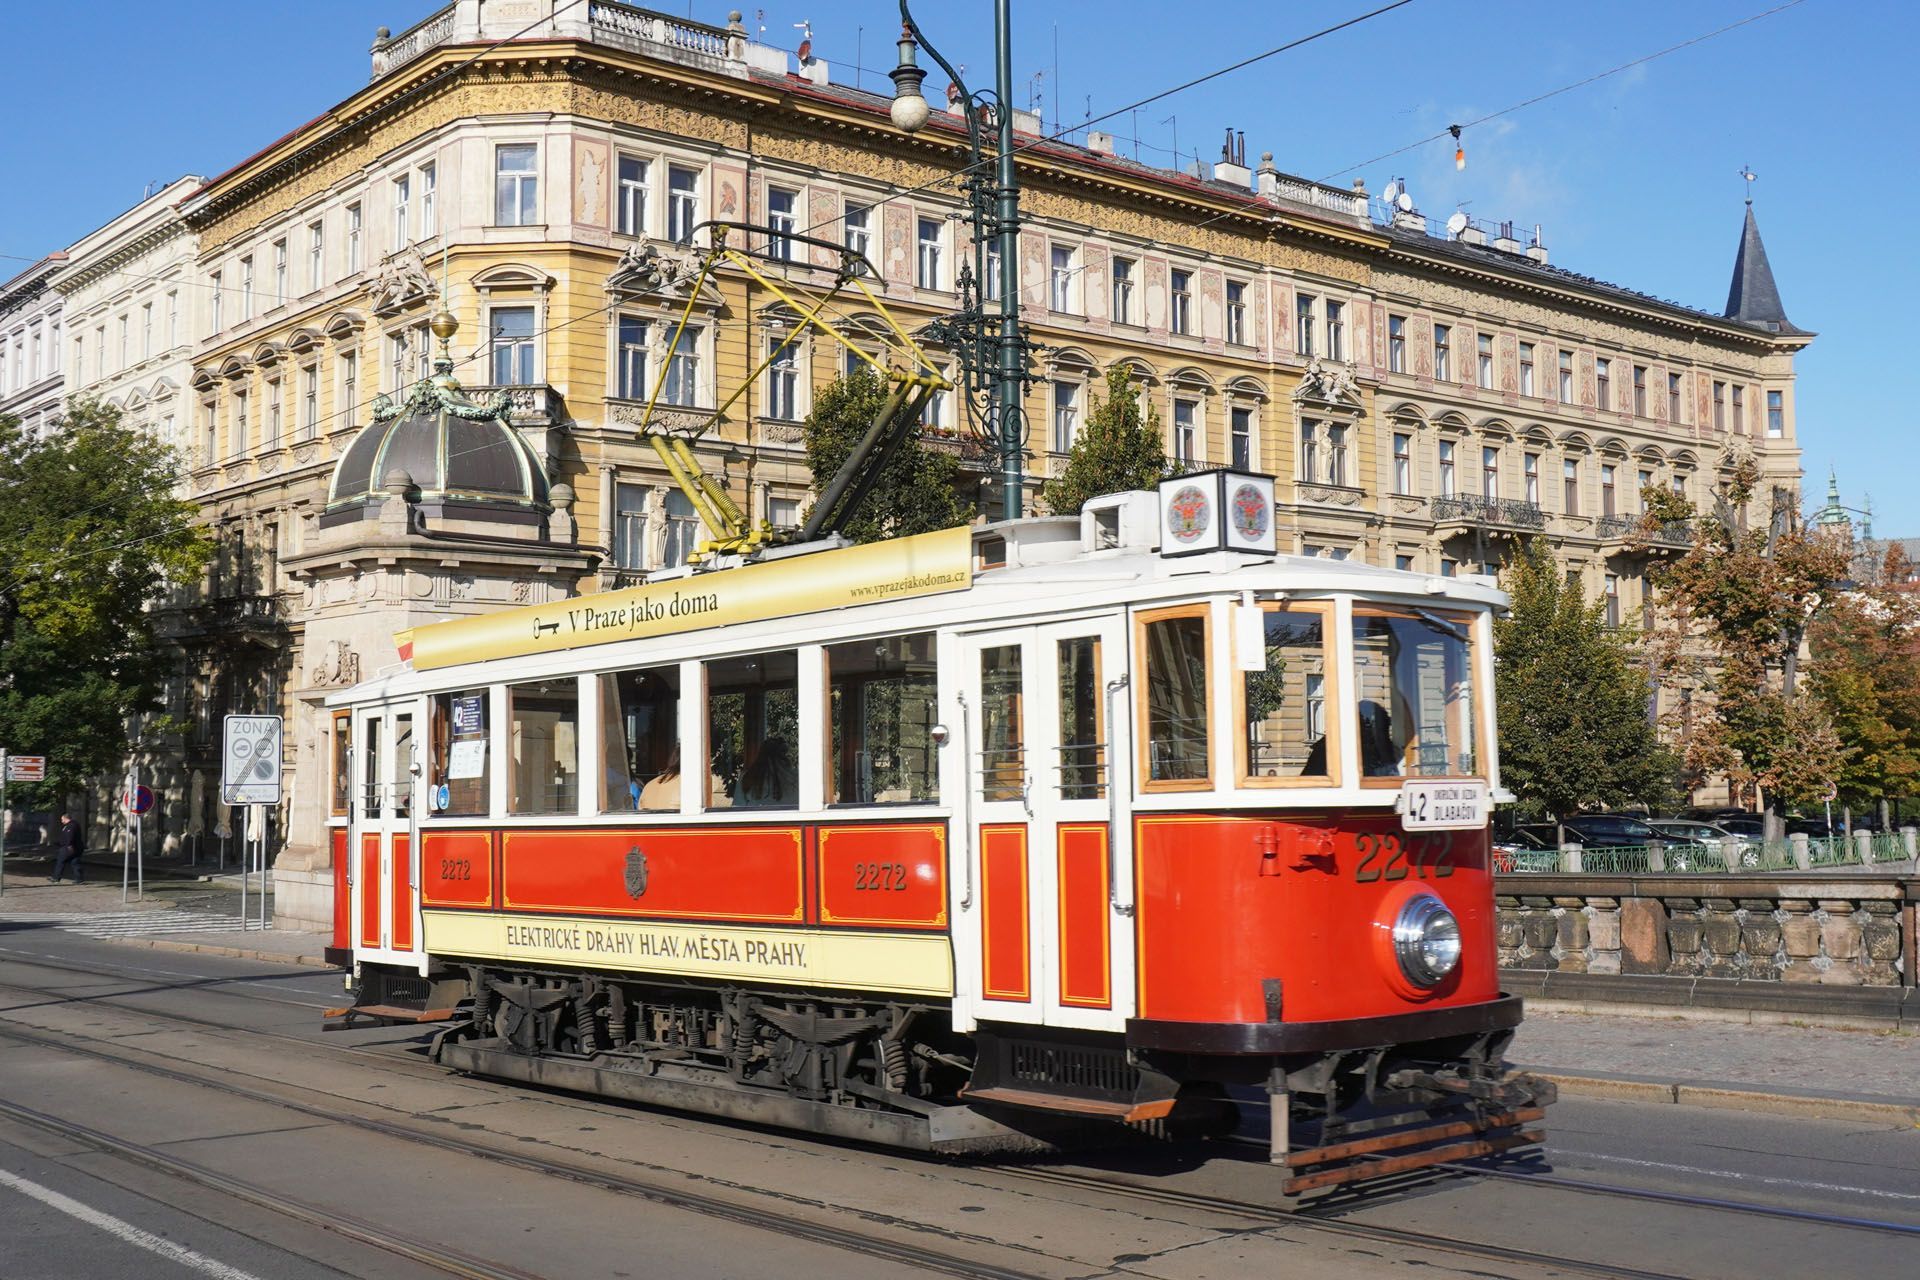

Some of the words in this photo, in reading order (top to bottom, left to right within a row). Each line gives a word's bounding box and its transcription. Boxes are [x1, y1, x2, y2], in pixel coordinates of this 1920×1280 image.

[850, 572, 965, 597] www.vprazejakodoma.cz
[569, 610, 580, 632] V
[585, 608, 626, 631] Praze
[630, 597, 664, 632] jako
[669, 592, 718, 617] doma
[233, 718, 275, 735] ZÓNA
[1410, 793, 1426, 821] 42
[441, 859, 471, 880] 2272
[1356, 830, 1454, 883] 2272
[855, 862, 907, 891] 2272
[507, 924, 581, 950] ELEKTRICKÉ
[586, 927, 634, 954] DRÁHY
[639, 933, 680, 958] HLAV.
[683, 934, 741, 962] MĚSTA
[745, 940, 808, 969] PRAHY.
